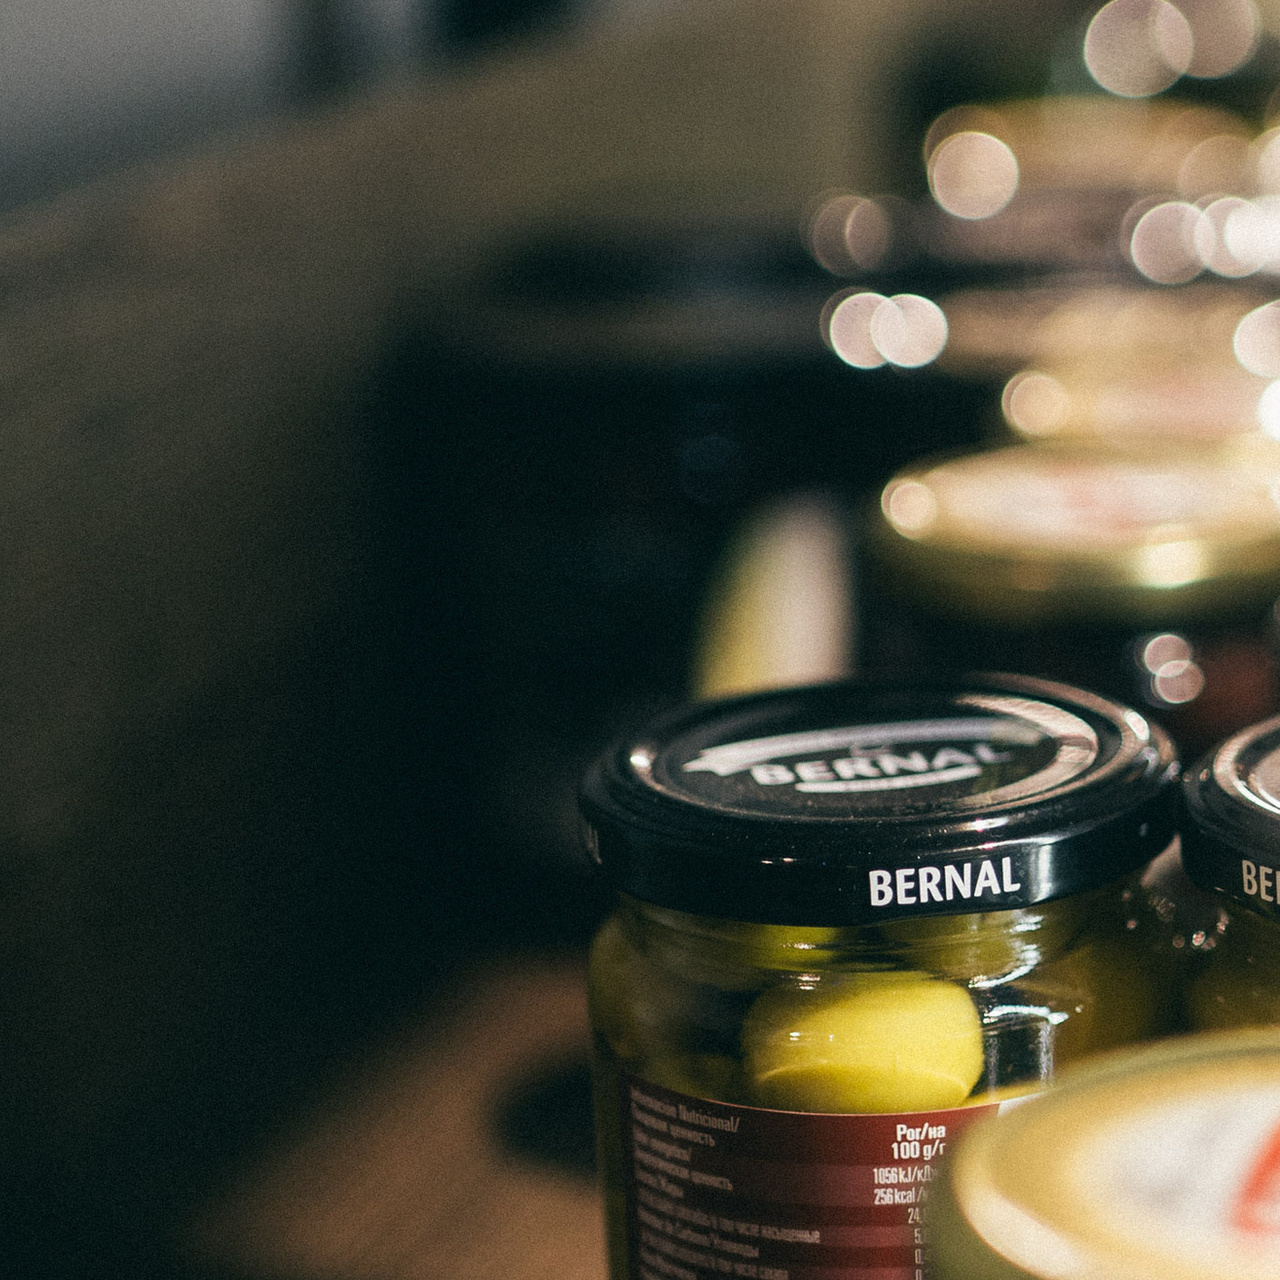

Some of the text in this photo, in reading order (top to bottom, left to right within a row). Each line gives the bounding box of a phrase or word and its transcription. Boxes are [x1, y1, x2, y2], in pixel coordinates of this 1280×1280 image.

[751, 742, 1011, 786] BERNAL
[869, 857, 1021, 907] BERNAL
[891, 1140, 920, 1160] 100
[873, 1166, 898, 1185] 1056
[874, 1187, 894, 1205] 256
